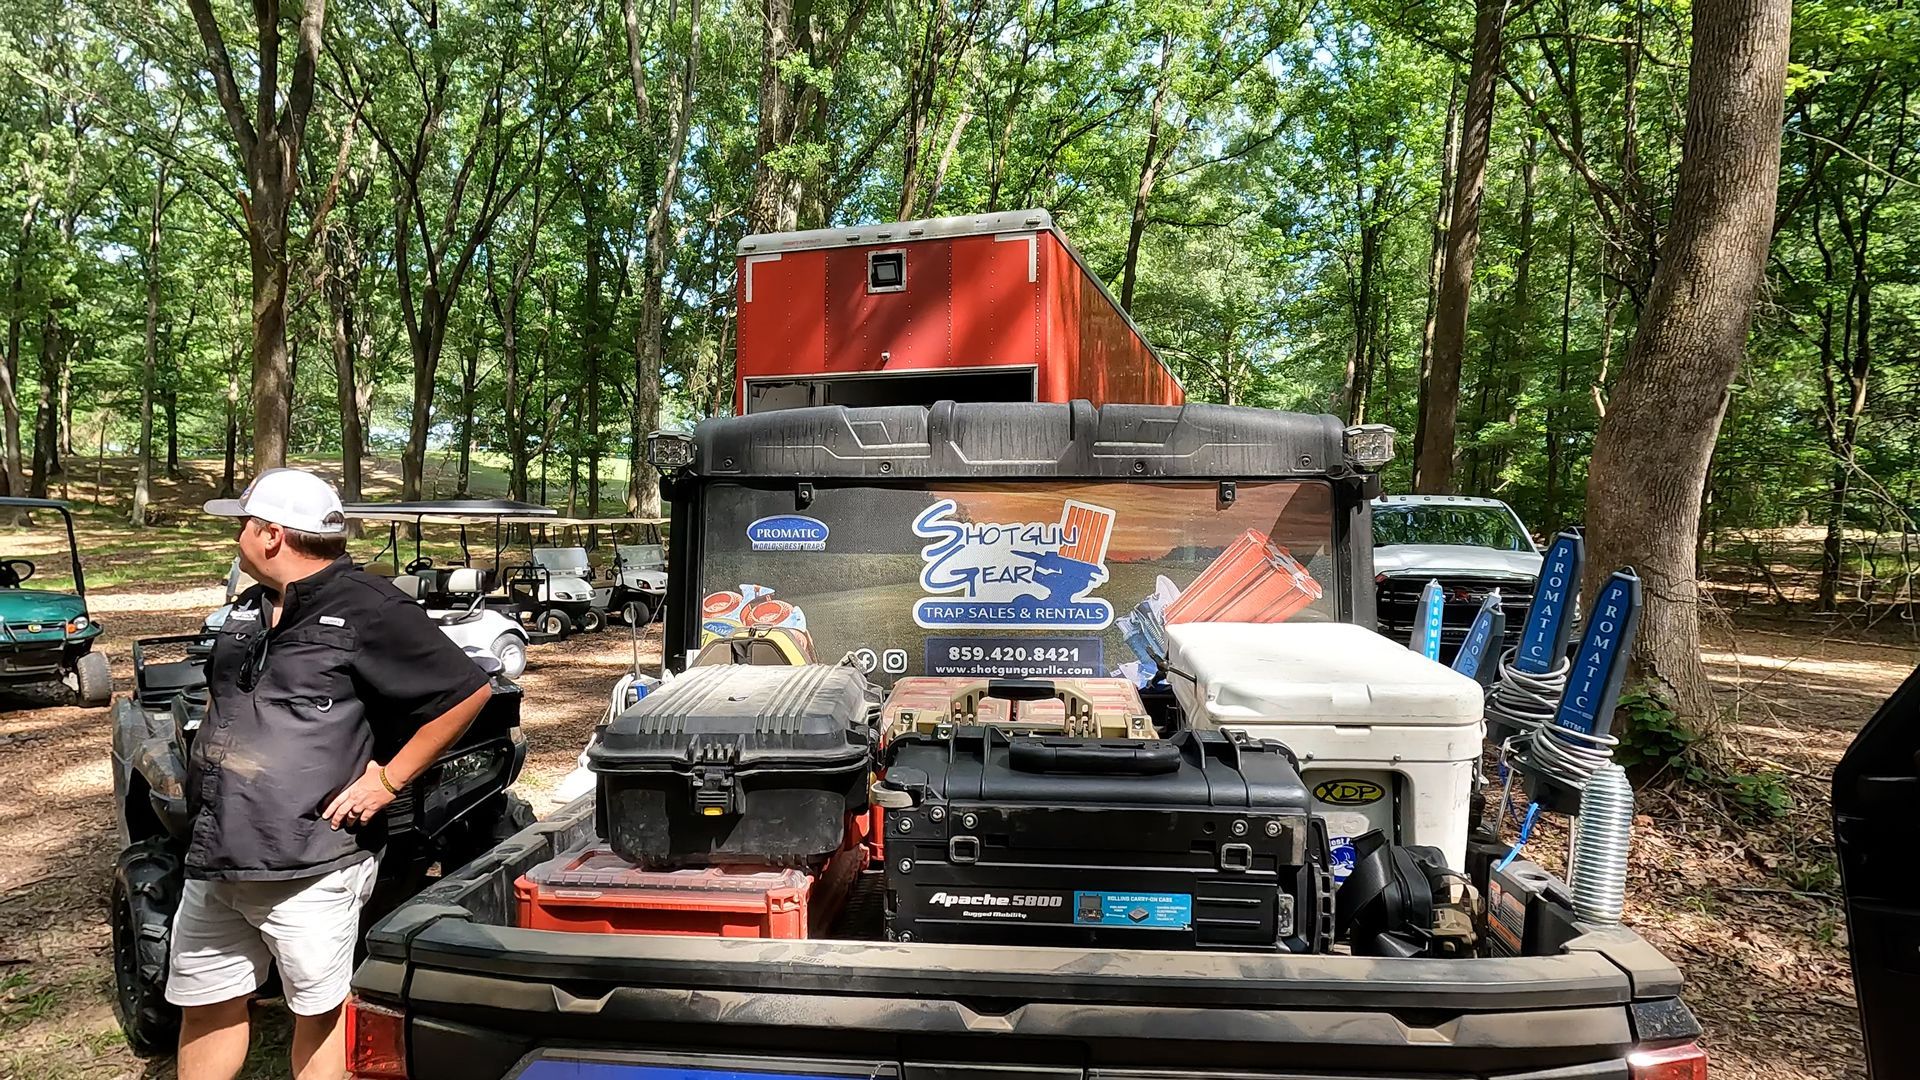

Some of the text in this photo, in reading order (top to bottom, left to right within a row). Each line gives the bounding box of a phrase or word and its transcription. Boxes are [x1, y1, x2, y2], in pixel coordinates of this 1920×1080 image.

[756, 528, 820, 538] PROMATIC
[753, 542, 825, 550] WORLD'S BEST TRAPS
[1531, 547, 1568, 656] PROMATIC
[924, 607, 1104, 620] TRAP SALES & RENTALS
[1428, 594, 1440, 660] PROMAT
[1471, 619, 1489, 656] PRO
[949, 646, 1080, 662] 859.420.8421
[1576, 588, 1623, 708] PROMATIC
[935, 664, 1093, 677] www.shotgungearllc.com
[1320, 781, 1377, 801] XDP
[929, 892, 1063, 907] Apache 5800
[963, 910, 1027, 919] Rugged Mobility
